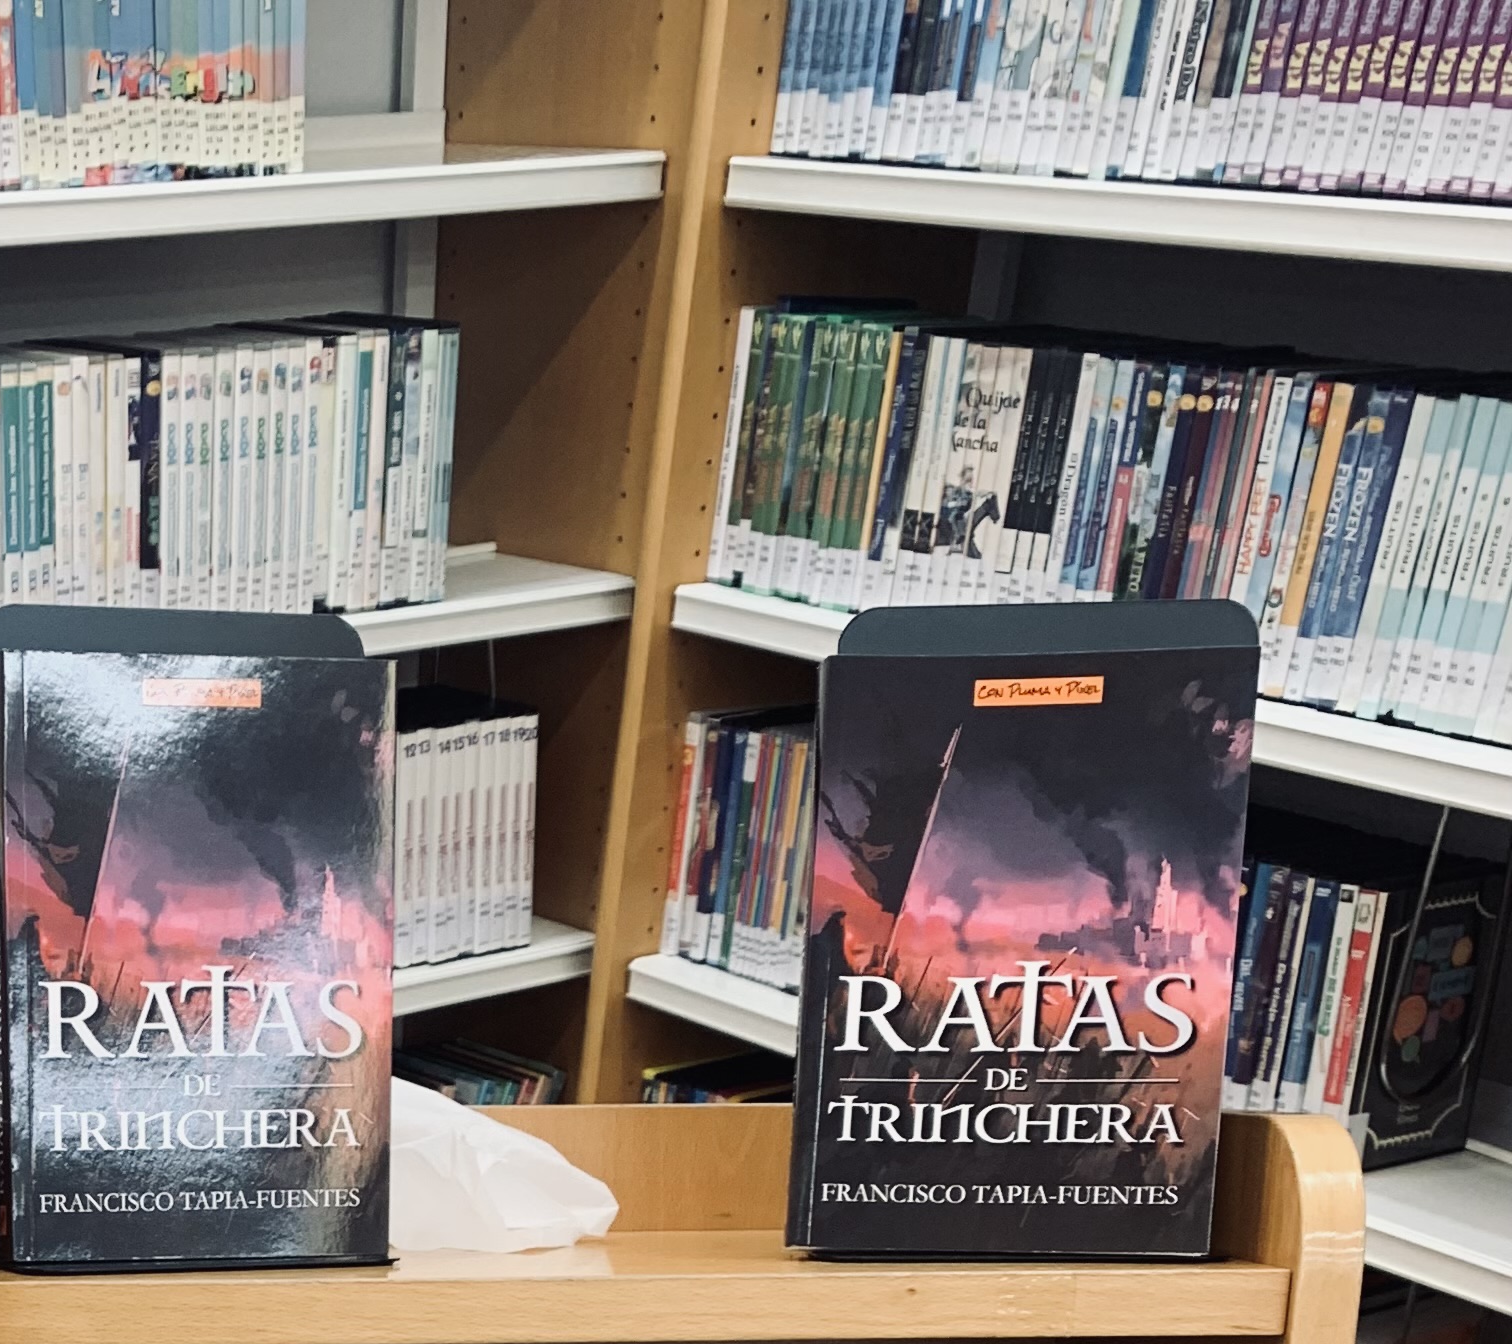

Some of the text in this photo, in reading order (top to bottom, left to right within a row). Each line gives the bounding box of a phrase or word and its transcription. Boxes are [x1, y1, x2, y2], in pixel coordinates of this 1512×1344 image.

[1323, 464, 1352, 538] FROZEN
[1343, 466, 1373, 542] FROZEN
[38, 964, 366, 1061] RATAS
[833, 960, 1197, 1055] RATAS
[183, 1074, 221, 1097] DE
[984, 1067, 1028, 1092] DE
[38, 1103, 361, 1153] TRINCHERA
[828, 1094, 1184, 1146] TRINCHERA
[39, 1187, 361, 1214] FRANCISCO TAPIA-FUENTES
[821, 1183, 1179, 1206] FRANCISCO TAPIA-FUENTES
